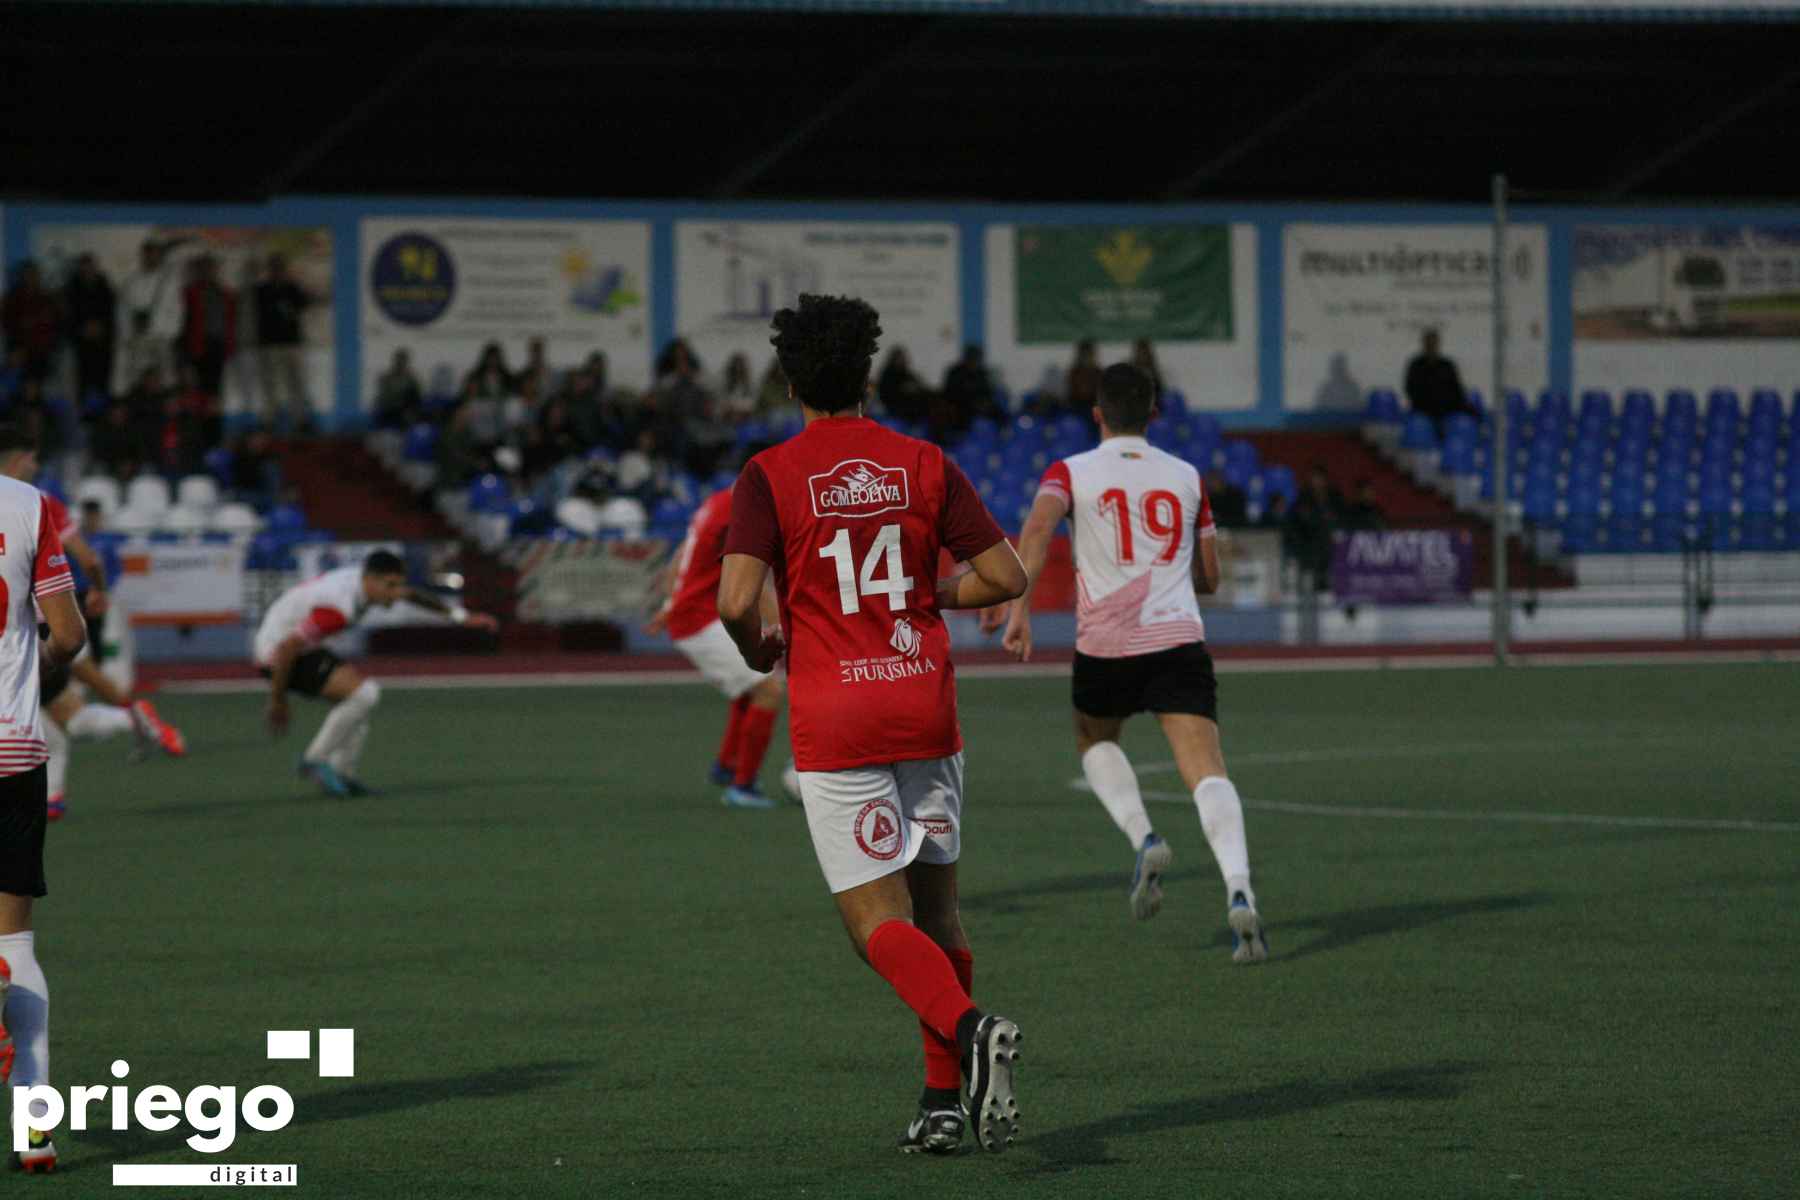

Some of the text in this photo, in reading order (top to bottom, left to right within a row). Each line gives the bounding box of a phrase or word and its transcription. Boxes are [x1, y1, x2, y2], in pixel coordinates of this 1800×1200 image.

[820, 484, 901, 507] GOMEOLIVA
[1097, 487, 1184, 566] 19
[818, 523, 914, 616] 14
[853, 657, 936, 682] PURÍSIMA
